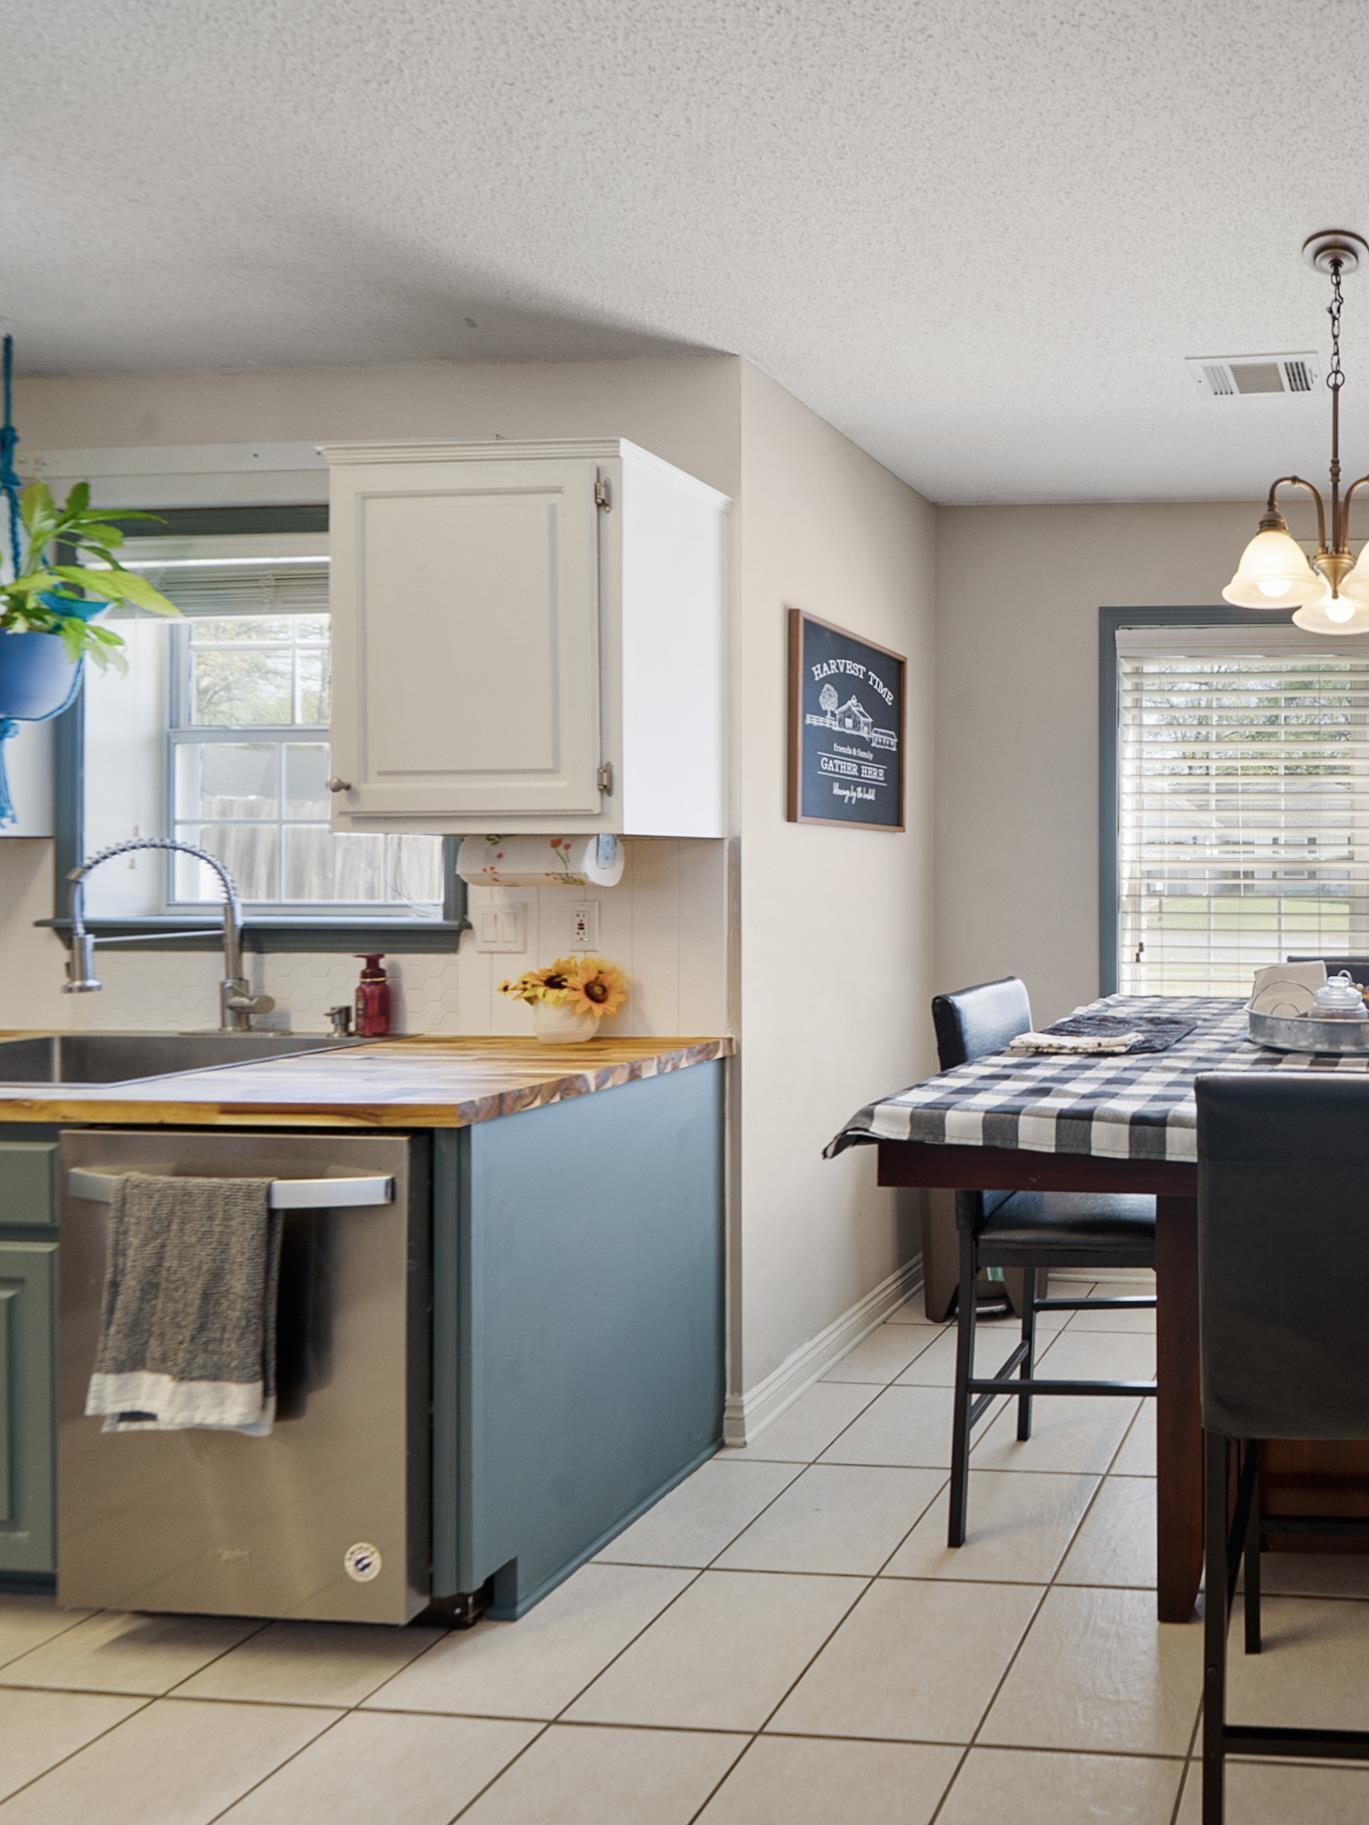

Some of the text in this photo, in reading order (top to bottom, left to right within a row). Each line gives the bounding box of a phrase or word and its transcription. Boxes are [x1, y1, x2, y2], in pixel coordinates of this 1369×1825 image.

[811, 659, 894, 706] HARVEST TIME
[820, 757, 885, 780] GATHER HERE
